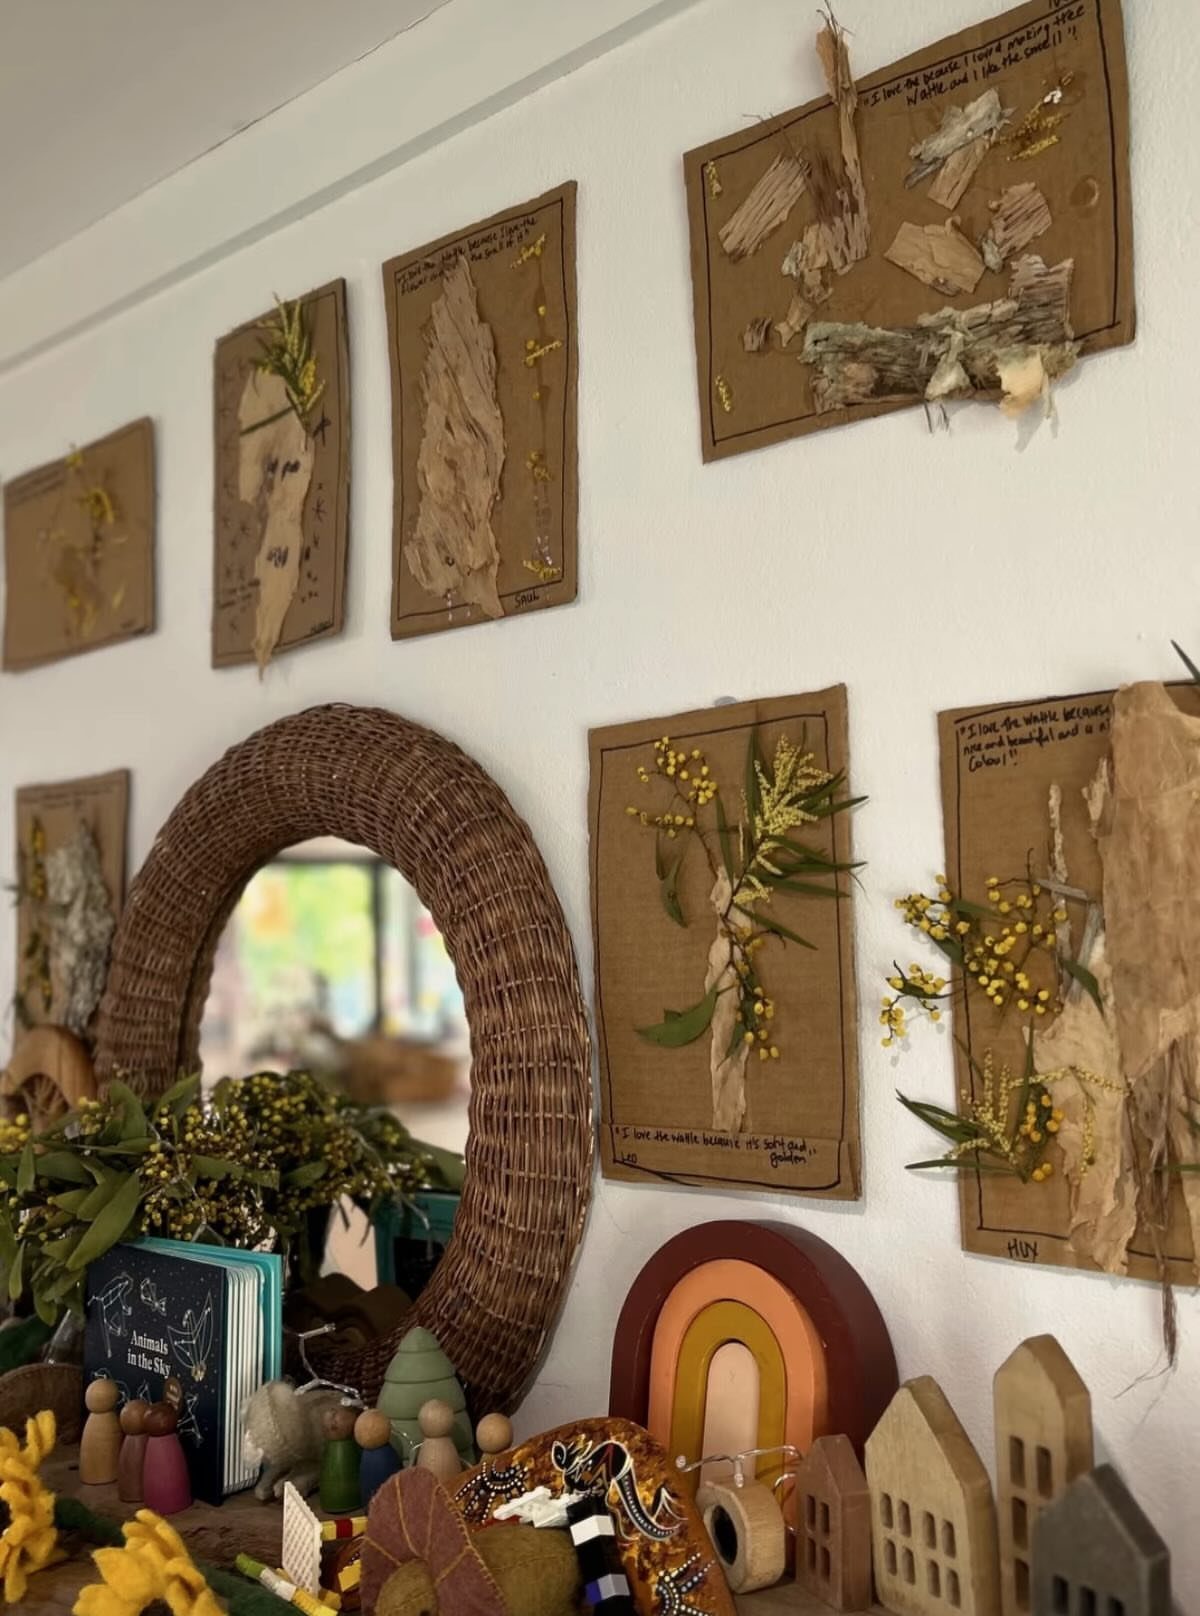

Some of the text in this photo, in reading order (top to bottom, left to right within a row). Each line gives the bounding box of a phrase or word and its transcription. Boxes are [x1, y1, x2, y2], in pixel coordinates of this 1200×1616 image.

[883, 83, 901, 101] love
[922, 61, 961, 85] because
[950, 72, 969, 91] and
[1002, 53, 1023, 69] the
[978, 721, 1000, 737] love
[1000, 715, 1022, 733] the
[1063, 703, 1110, 722] because
[984, 735, 1005, 750] and
[1058, 722, 1079, 741] and
[633, 1127, 651, 1141] love
[654, 1129, 671, 1143] the
[671, 1131, 700, 1145] wattle
[702, 1131, 741, 1150] because
[763, 1134, 785, 1151] soft
[786, 1138, 807, 1152] and
[131, 1330, 168, 1355] Animals
[127, 1347, 172, 1380] in the Sky
